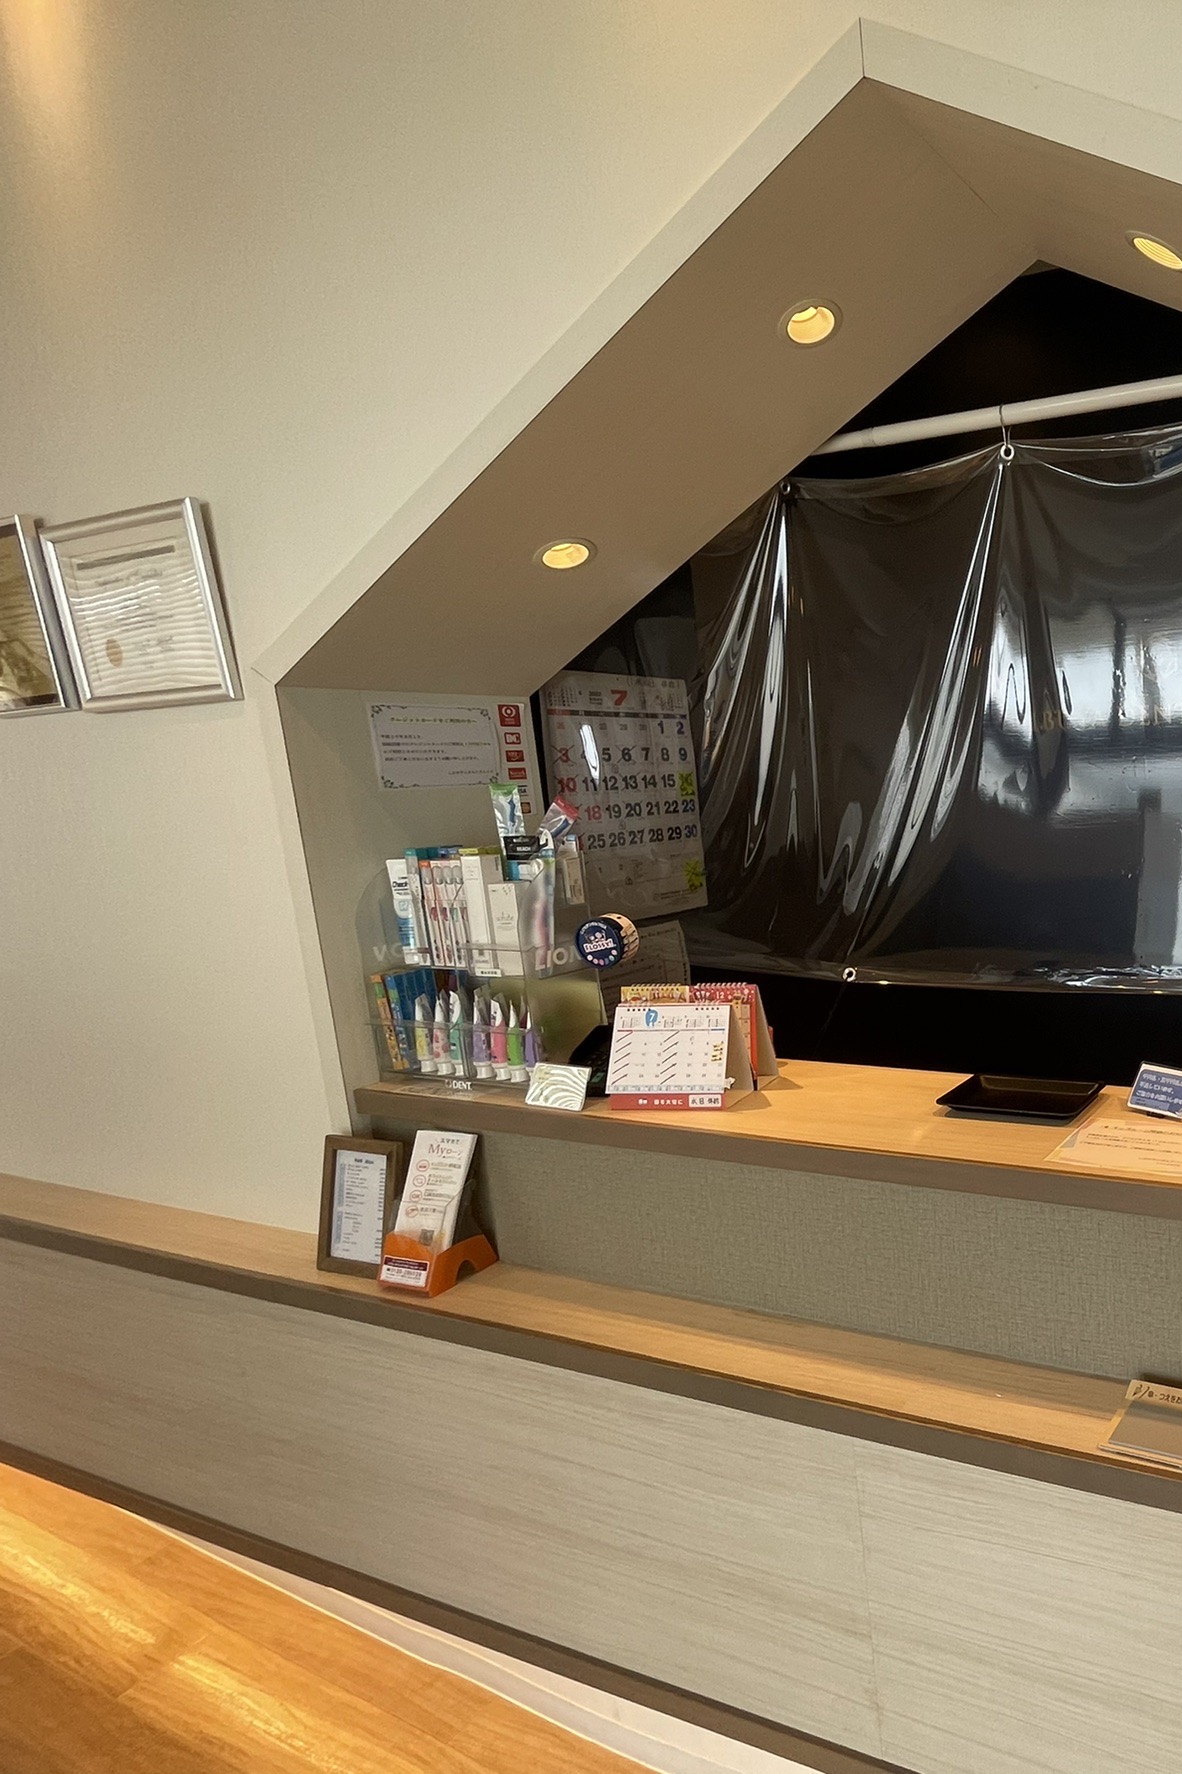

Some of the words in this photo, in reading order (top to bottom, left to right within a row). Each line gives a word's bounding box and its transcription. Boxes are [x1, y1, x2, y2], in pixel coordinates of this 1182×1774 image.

[610, 689, 627, 706] 7
[657, 720, 665, 735] 1
[676, 721, 685, 735] 2
[602, 747, 611, 762] 5
[640, 748, 651, 761] 7
[661, 747, 669, 761] 8
[678, 746, 688, 760] 9
[602, 776, 618, 791] 12
[622, 775, 638, 790] 13
[641, 774, 658, 789] 14
[661, 774, 676, 788] 15
[585, 805, 602, 821] 18
[605, 804, 622, 819] 19
[625, 803, 642, 818] 20
[646, 802, 661, 816] 21
[664, 800, 680, 815] 22
[682, 800, 696, 814] 23
[587, 834, 606, 850] 25
[608, 833, 626, 848] 26
[628, 829, 645, 845] 27
[648, 828, 664, 843] 28
[667, 826, 682, 841] 29
[684, 824, 697, 839] 30
[584, 940, 613, 951] FLOSSY!
[715, 991, 725, 1000] 12
[649, 1012, 656, 1022] 7
